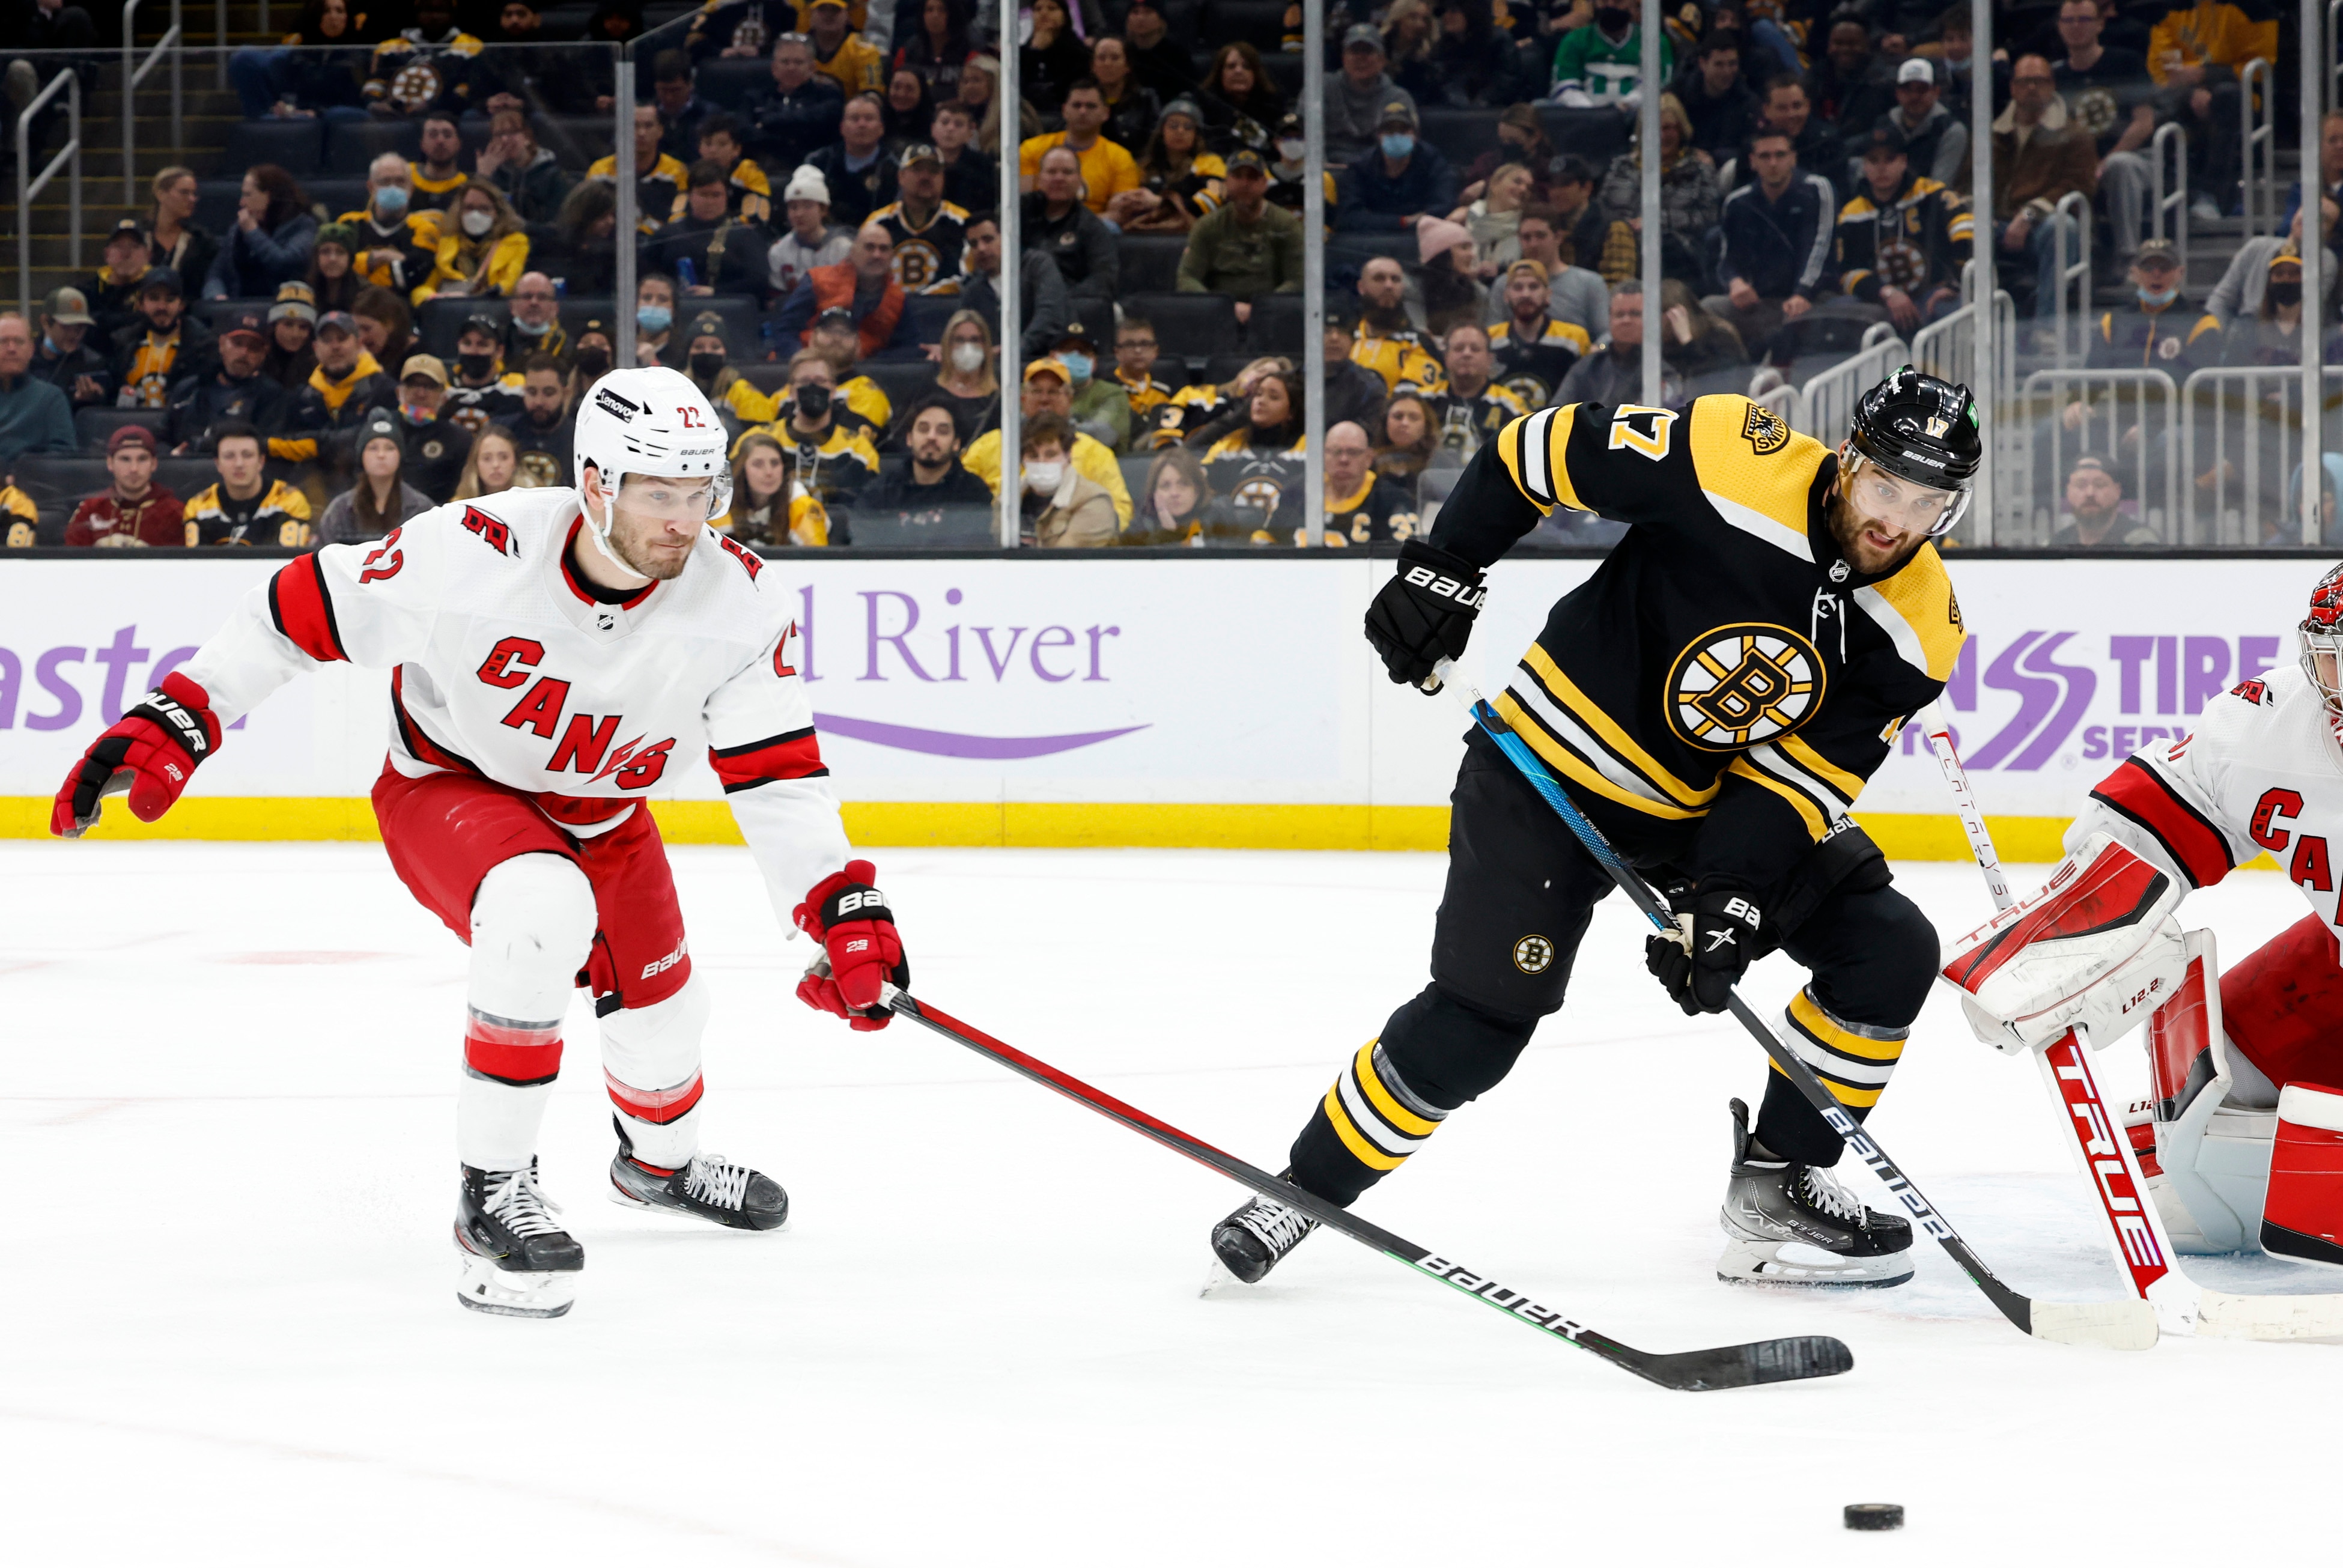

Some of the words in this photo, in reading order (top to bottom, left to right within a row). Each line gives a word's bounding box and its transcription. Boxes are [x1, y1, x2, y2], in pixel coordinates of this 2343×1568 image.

[600, 390, 633, 419] Lenovo
[676, 406, 706, 428] 22
[1925, 416, 1949, 439] 17
[1901, 449, 1946, 470] BAUER
[1351, 512, 1372, 543] C
[857, 588, 1121, 683] River
[476, 636, 677, 791] CANES
[1585, 819, 1610, 846] FOLIGNO
[1954, 859, 2078, 947] TRUE
[1820, 1106, 1954, 1241] BAUER
[2053, 1045, 2162, 1267] TRUE
[1414, 1253, 1587, 1342] BAUER
